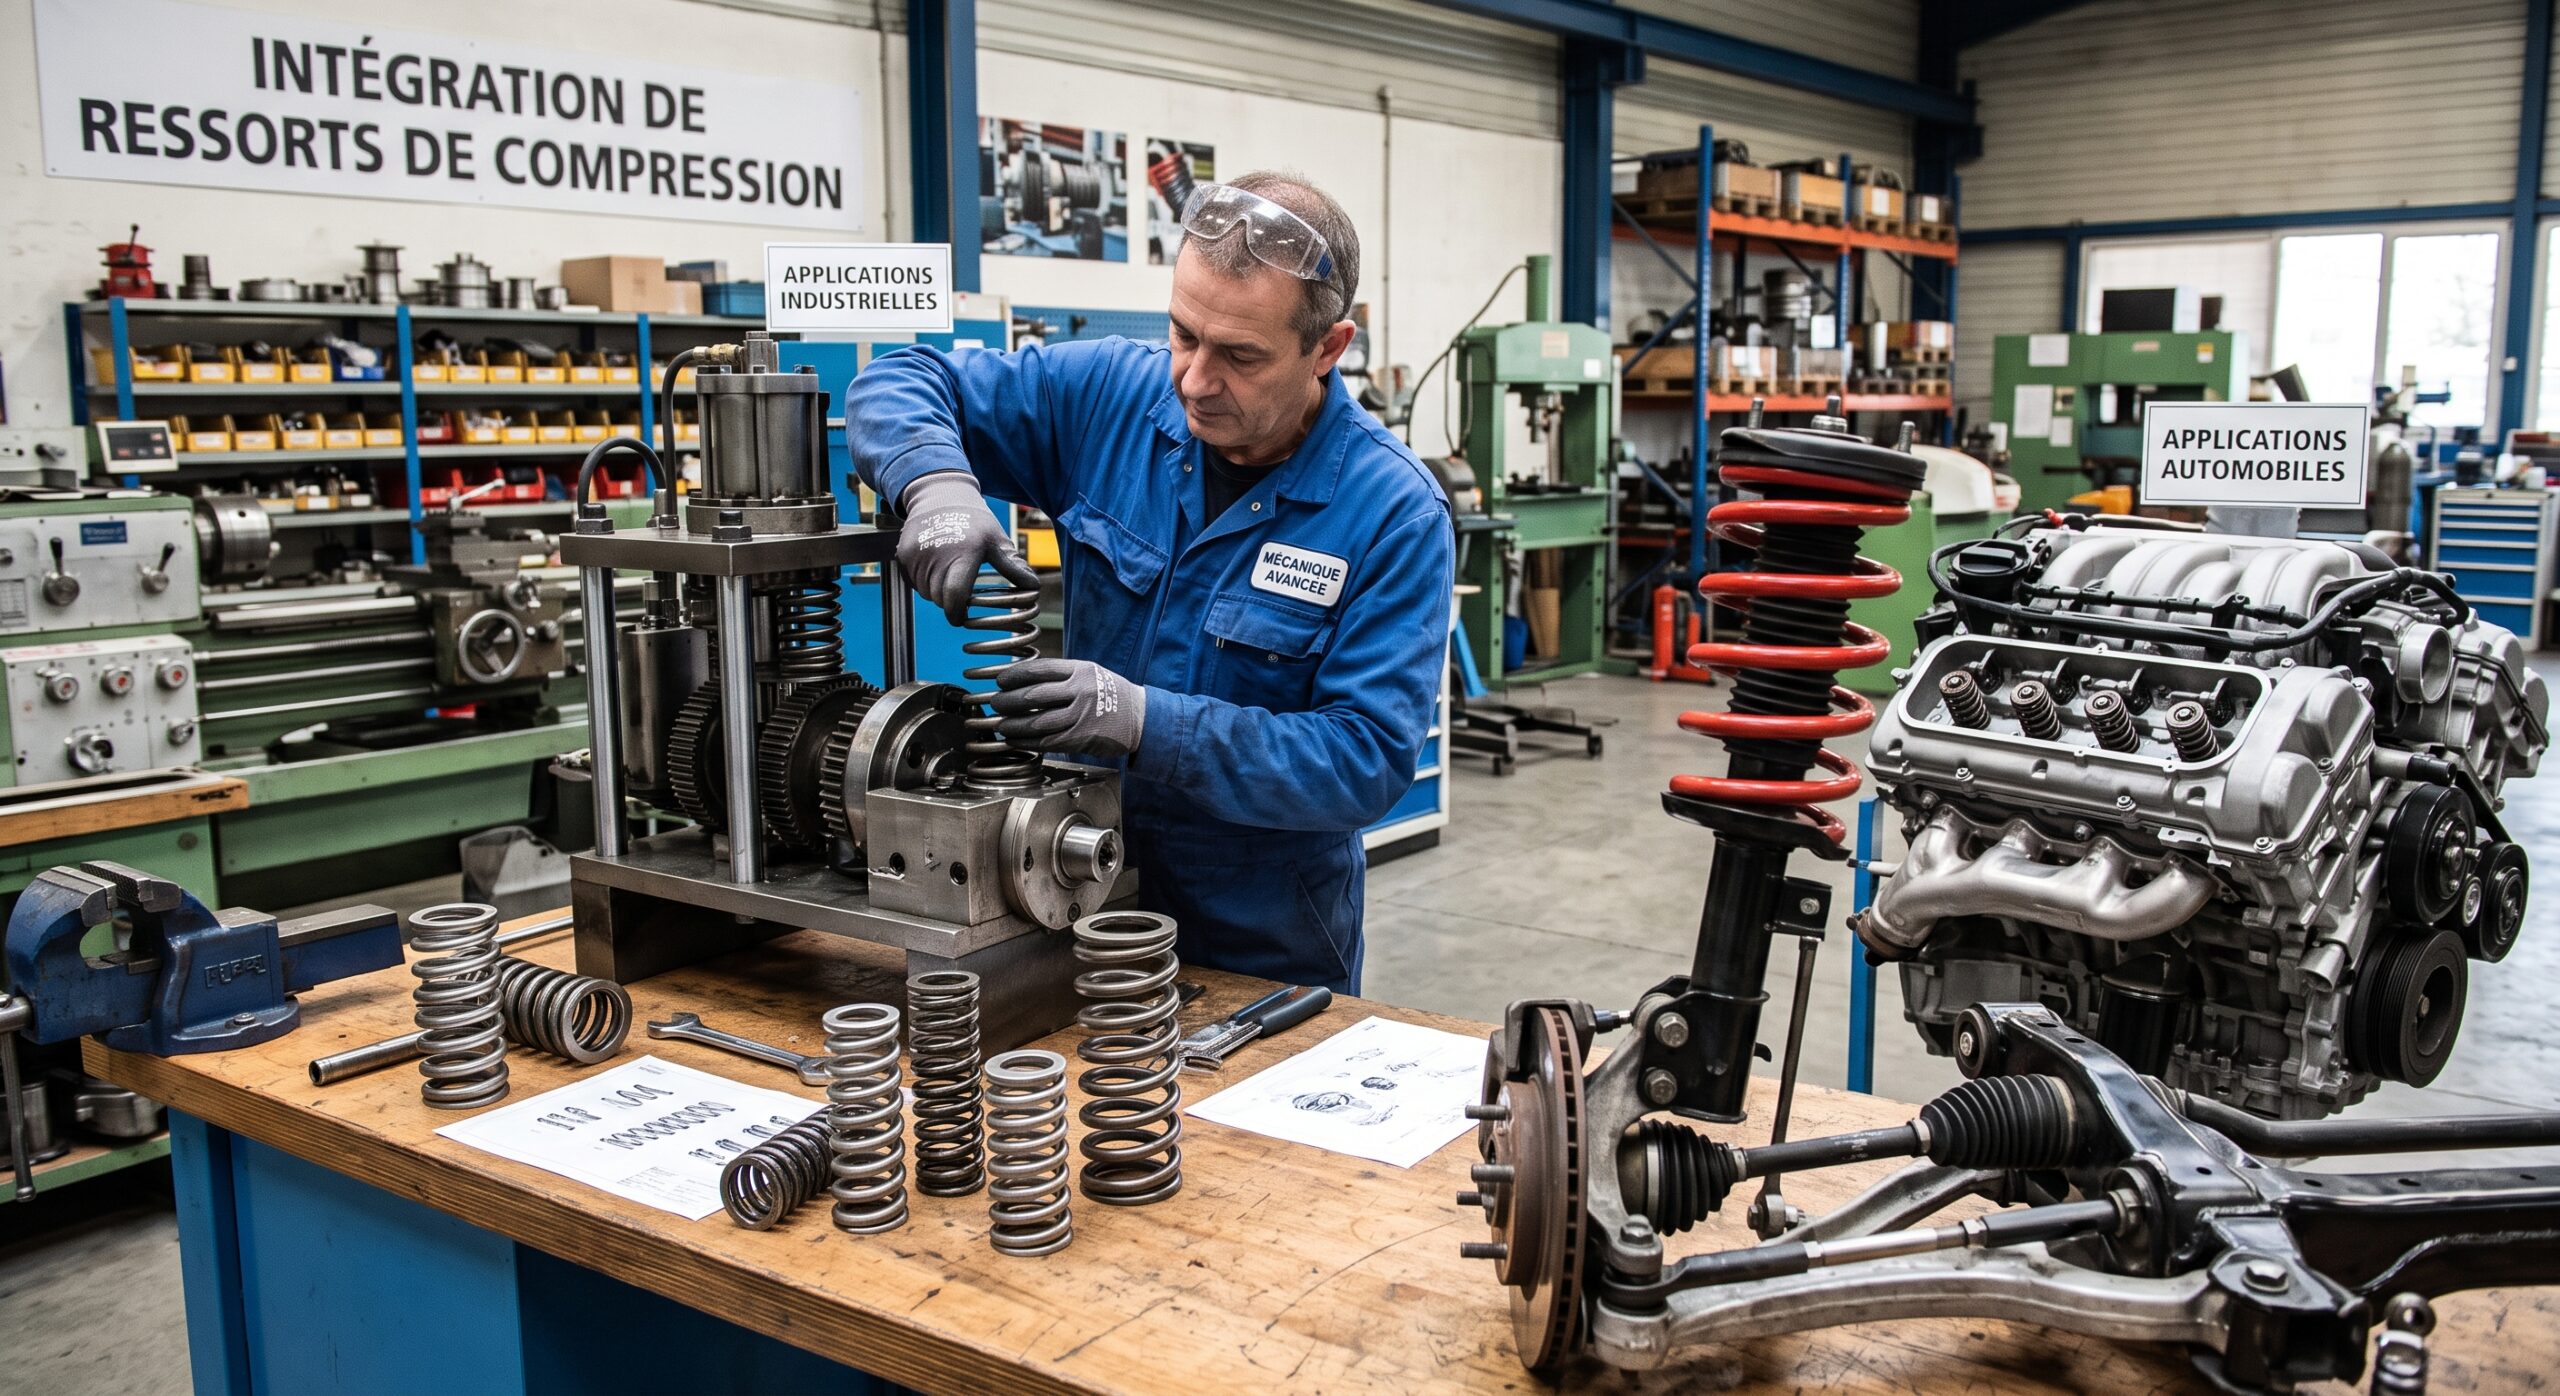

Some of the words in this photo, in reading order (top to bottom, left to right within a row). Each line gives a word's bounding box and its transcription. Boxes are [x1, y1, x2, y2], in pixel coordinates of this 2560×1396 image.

[251, 36, 625, 125] INTÉGRATION
[643, 82, 706, 133] DE
[79, 97, 384, 173] RESSORTS
[404, 128, 476, 181] DE
[495, 136, 843, 210] COMPRESSION
[783, 265, 934, 285] APPLICATIONS
[780, 291, 938, 311] INDUSTRIELLES
[2161, 428, 2348, 452] APPLICATIONS
[2160, 458, 2346, 482] AUTOMOBILES
